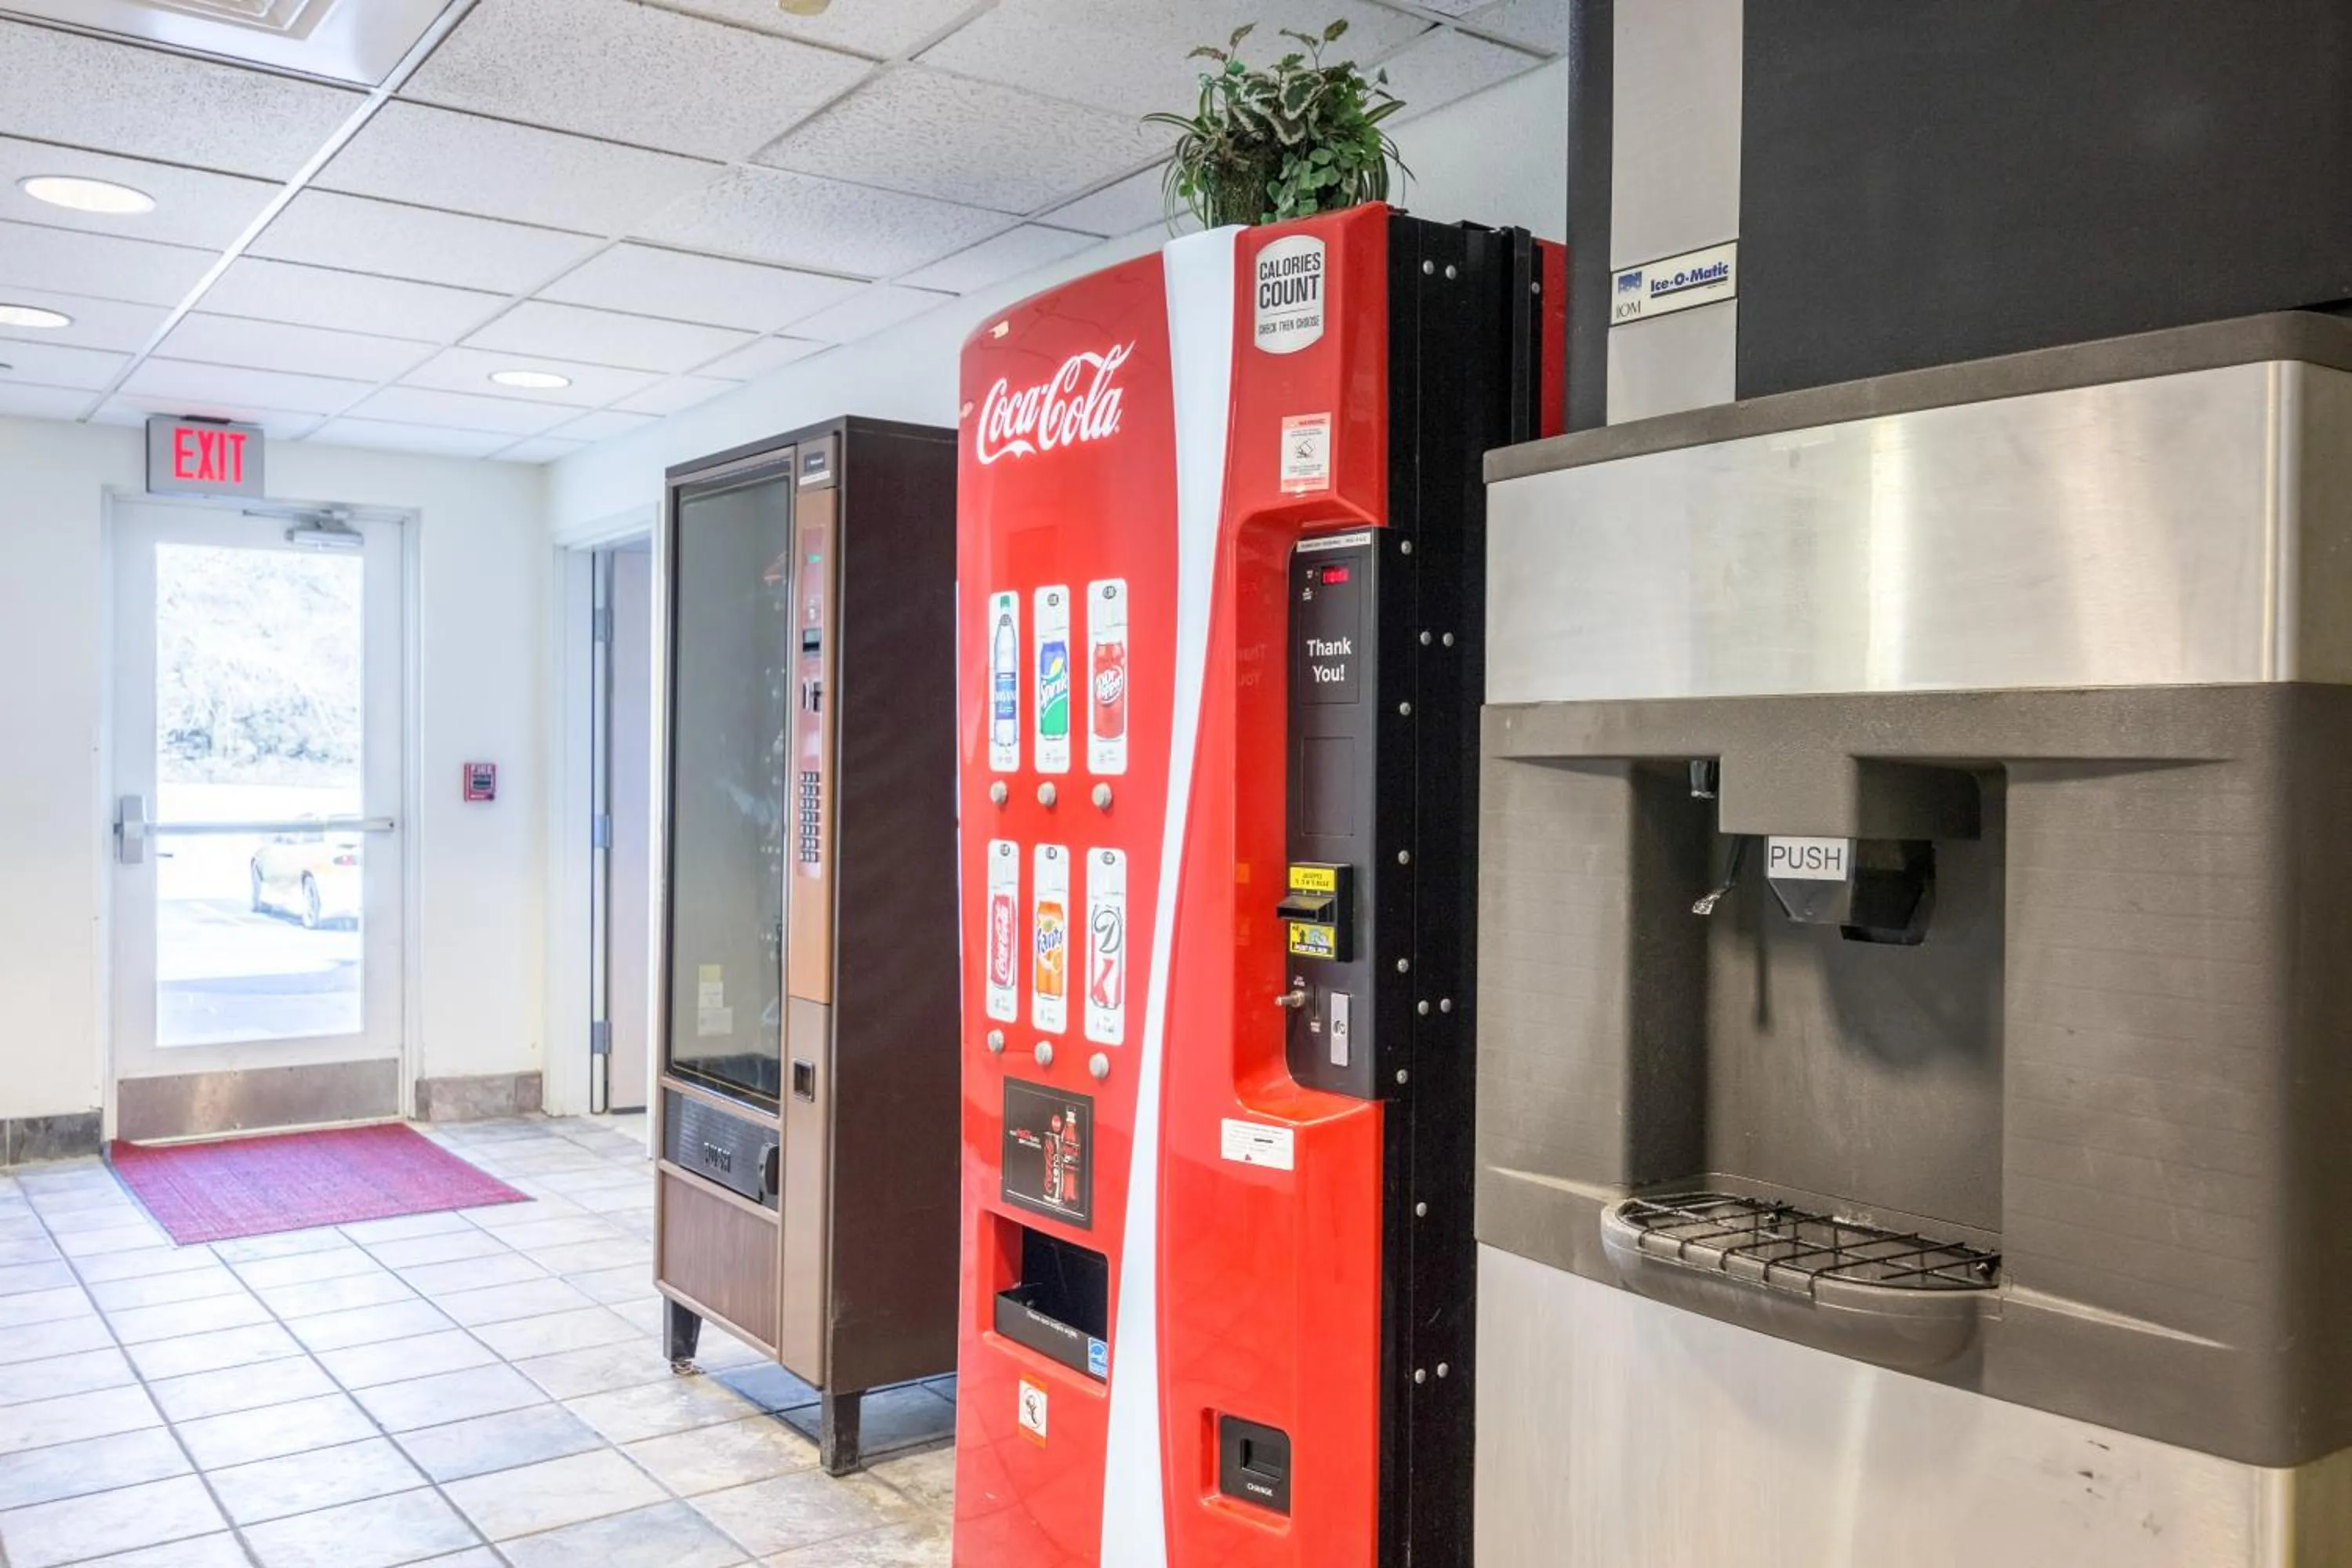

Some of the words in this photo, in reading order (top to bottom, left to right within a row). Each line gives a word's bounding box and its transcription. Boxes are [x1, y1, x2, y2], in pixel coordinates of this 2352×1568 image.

[1260, 252, 1321, 281] CALORIES
[1259, 274, 1320, 309] COUNT
[174, 427, 247, 484] EXIT
[1306, 637, 1352, 657] Thank
[1312, 665, 1345, 683] You!
[1770, 846, 1841, 871] PUSH
